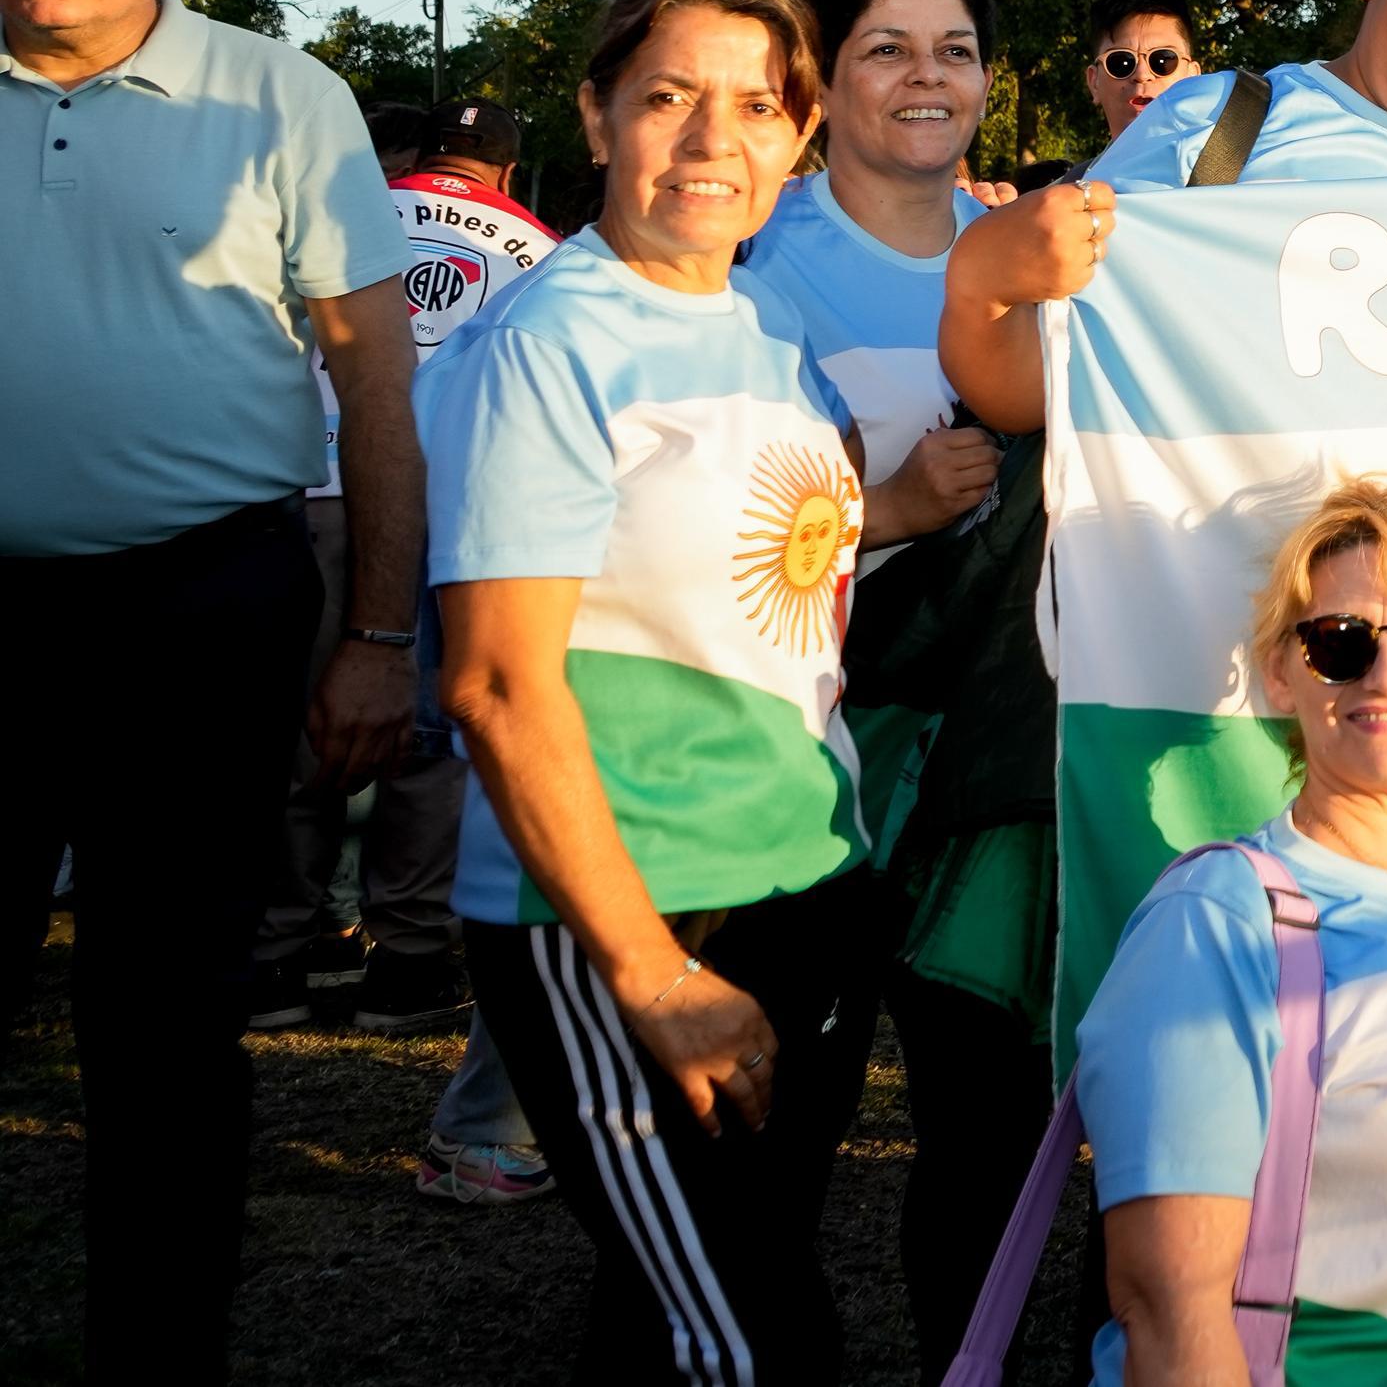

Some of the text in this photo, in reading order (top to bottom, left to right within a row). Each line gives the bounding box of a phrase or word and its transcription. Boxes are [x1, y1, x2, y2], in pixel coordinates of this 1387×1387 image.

[415, 204, 499, 238] pibes
[503, 238, 534, 268] de
[404, 261, 464, 311] CARP
[416, 323, 434, 335] 1901
